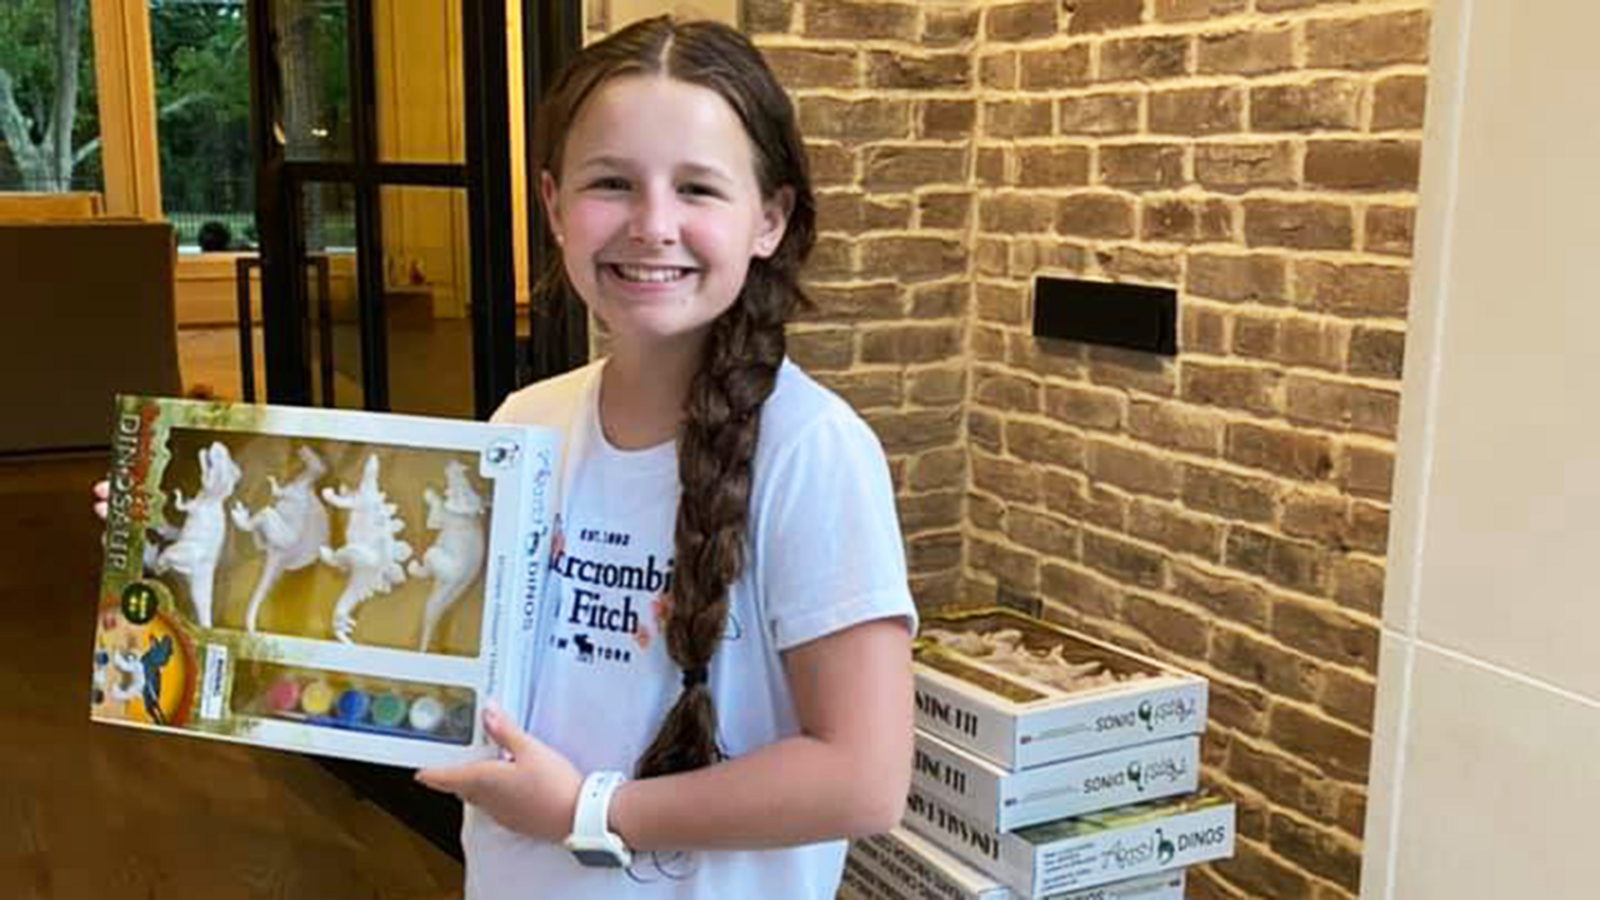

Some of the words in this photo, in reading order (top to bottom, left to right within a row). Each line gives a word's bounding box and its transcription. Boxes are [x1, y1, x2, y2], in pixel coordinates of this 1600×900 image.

[109, 413, 142, 570] DINOSAUR
[549, 551, 674, 593] rcrombi
[522, 561, 538, 632] DINOS
[568, 588, 638, 634] Fitch
[1095, 710, 1136, 733] DINOS
[1083, 771, 1126, 794] DINOS
[1177, 825, 1226, 853] DINOS
